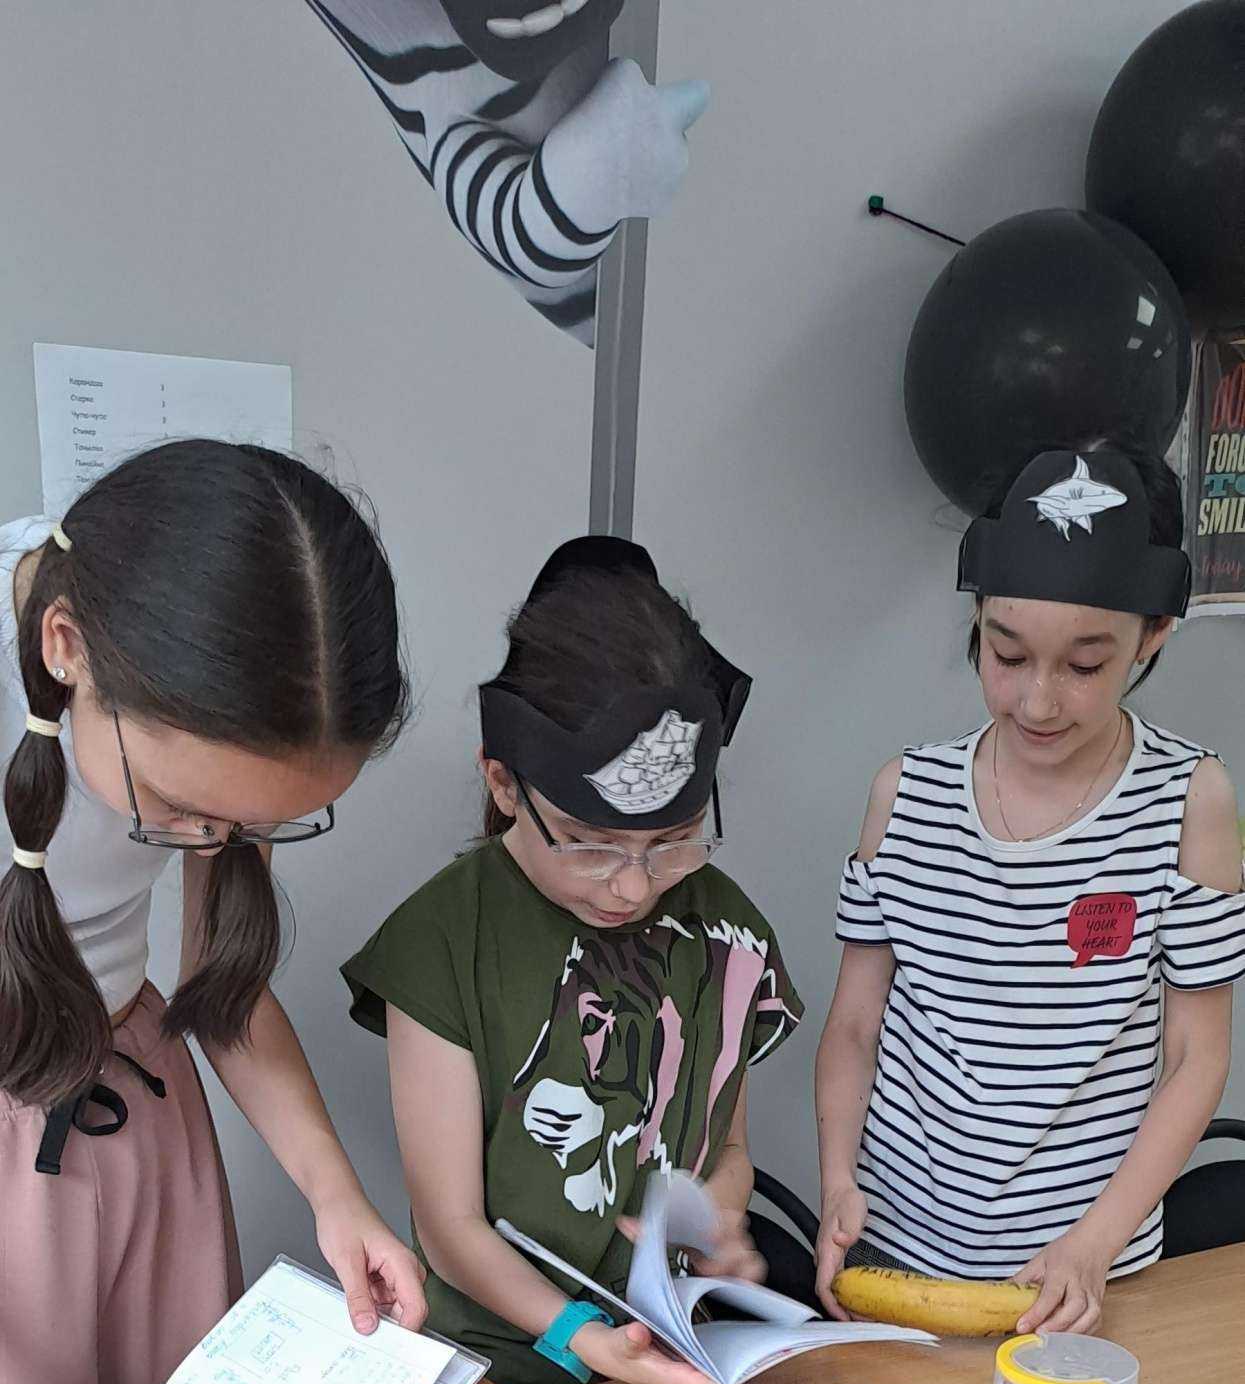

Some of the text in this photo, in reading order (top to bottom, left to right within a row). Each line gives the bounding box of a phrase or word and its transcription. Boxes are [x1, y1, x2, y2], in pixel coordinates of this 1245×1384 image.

[1074, 902, 1132, 916] LISTEN TO
[1086, 919, 1117, 936] YOUR
[1081, 936, 1122, 950] HEART
